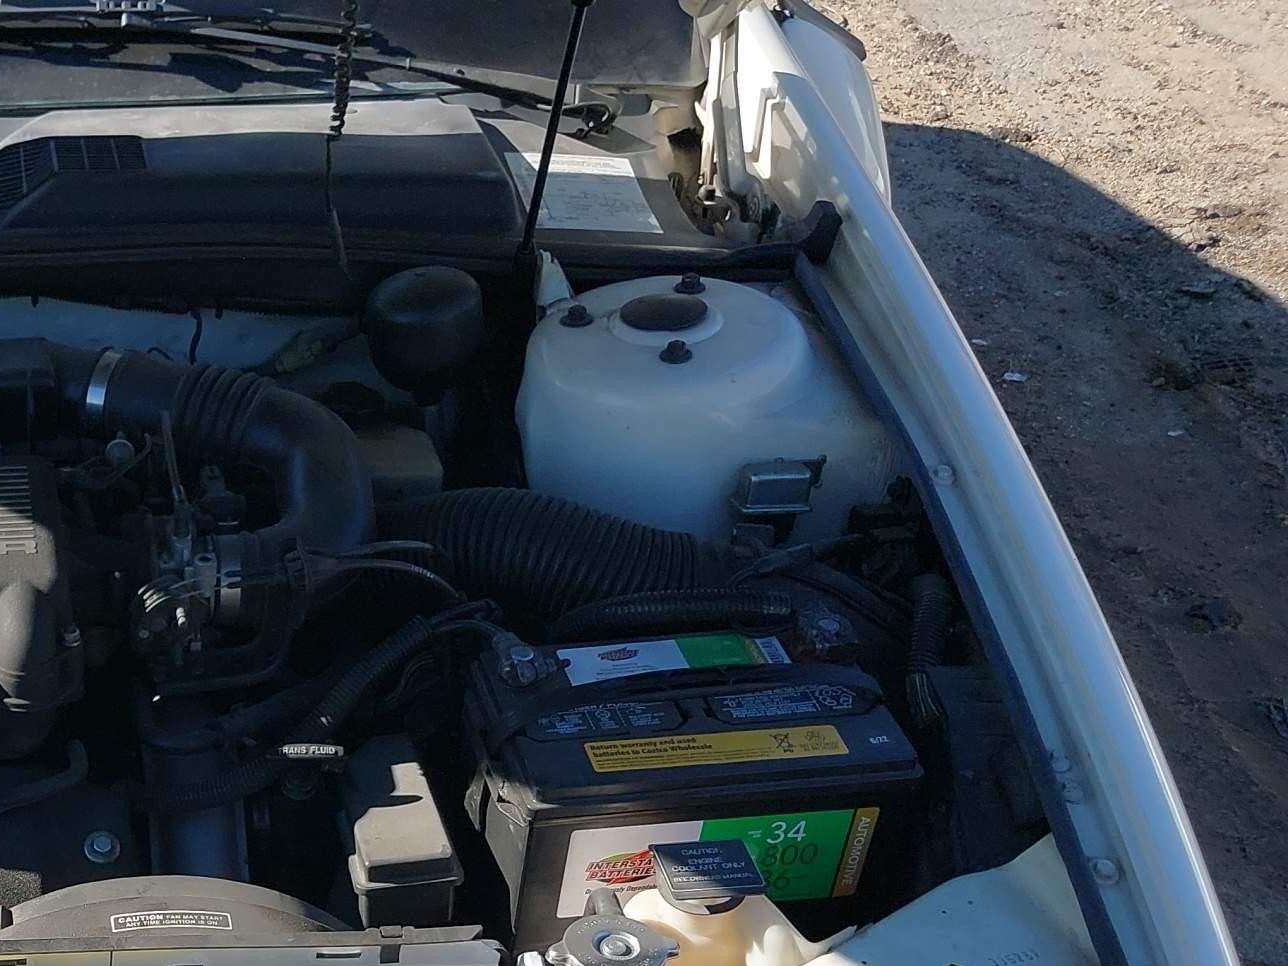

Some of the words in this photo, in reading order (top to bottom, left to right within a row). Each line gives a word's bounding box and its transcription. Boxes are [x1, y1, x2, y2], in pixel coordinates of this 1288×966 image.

[278, 746, 306, 755] TRANS
[308, 746, 336, 755] FLUID
[592, 750, 631, 758] batteries
[669, 743, 712, 751] Wholesale
[620, 742, 657, 750] warranty
[766, 820, 807, 844] 34
[760, 842, 818, 868] 800
[840, 816, 870, 886] AUTOMOTIVE
[586, 860, 653, 871] INTERSTA
[672, 864, 718, 872] COOLANT
[118, 914, 164, 924] CAUTION
